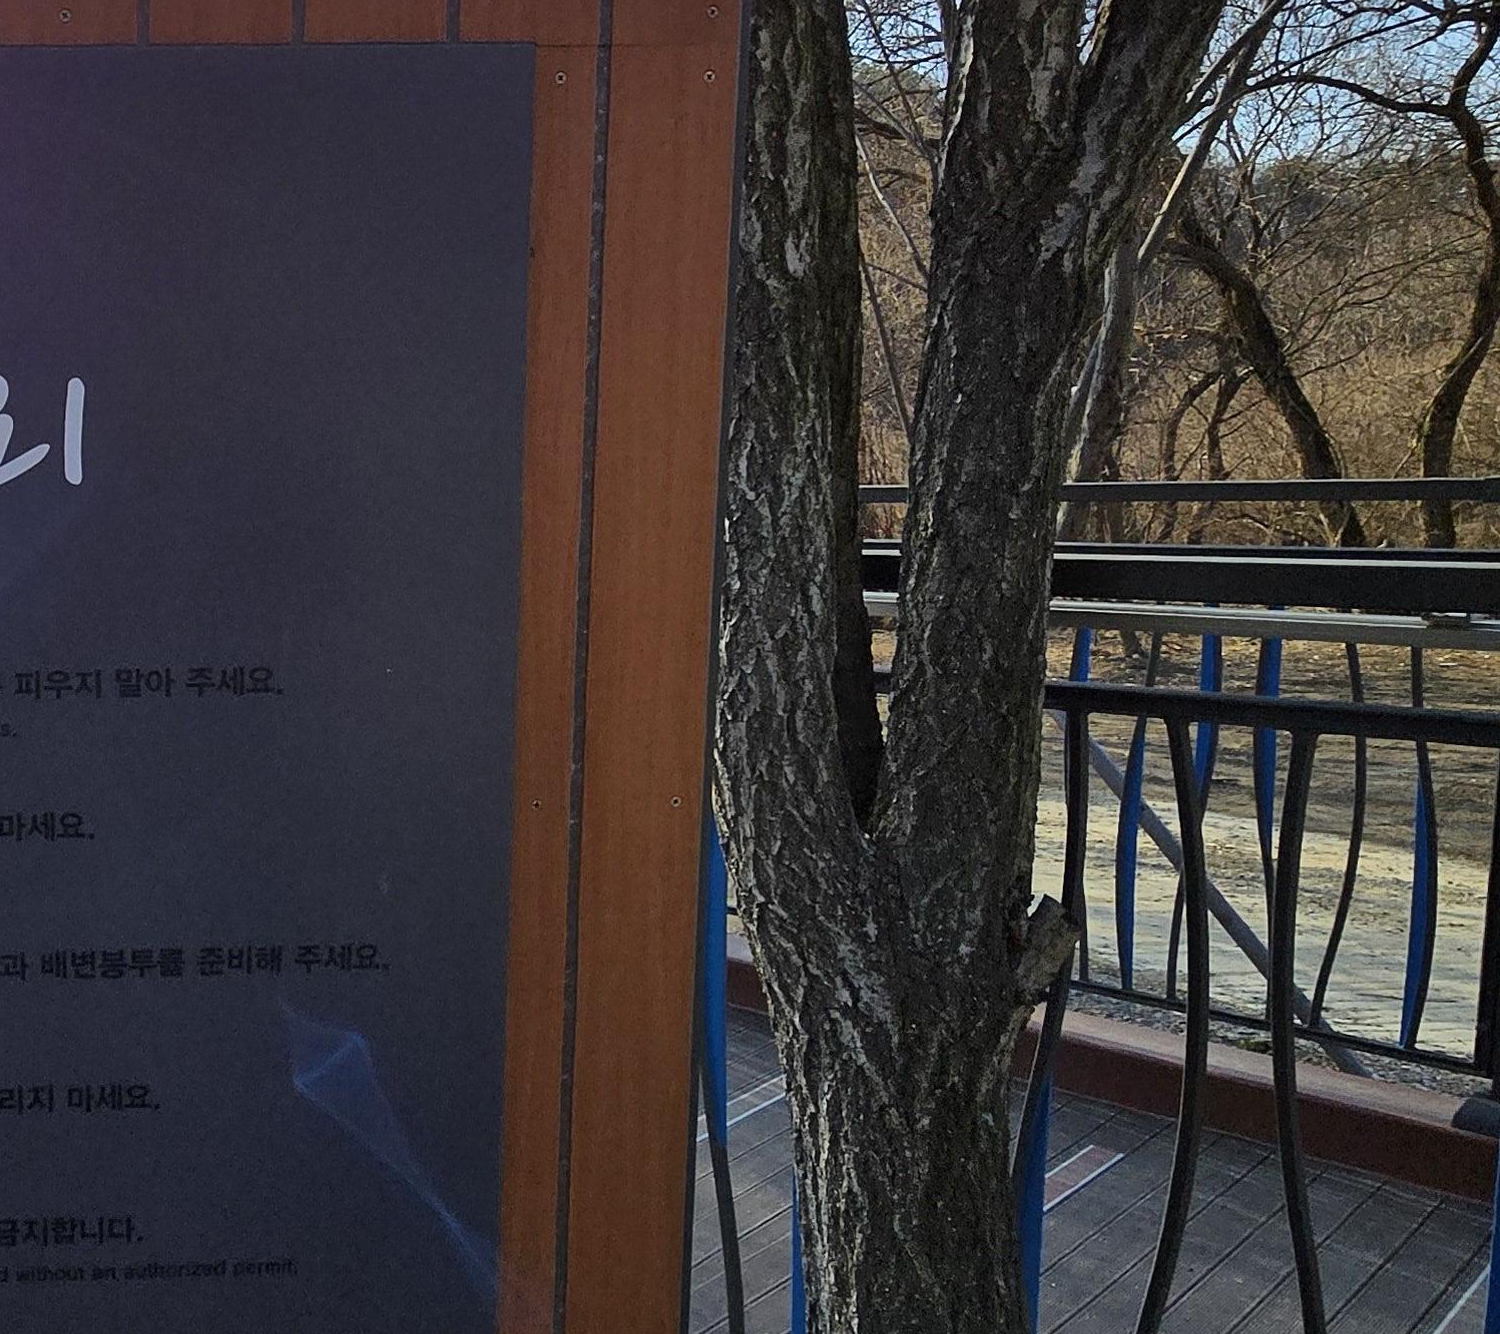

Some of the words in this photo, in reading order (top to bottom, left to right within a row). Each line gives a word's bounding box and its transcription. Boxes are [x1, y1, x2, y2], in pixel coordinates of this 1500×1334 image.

[14, 669, 102, 699] 피우지
[114, 667, 176, 698] 말아
[185, 666, 283, 697] 주세요.
[40, 946, 185, 979] 배변봉투를
[199, 945, 283, 976] 준비해
[294, 943, 390, 972] 주세요.
[67, 1084, 160, 1113] 마세요.
